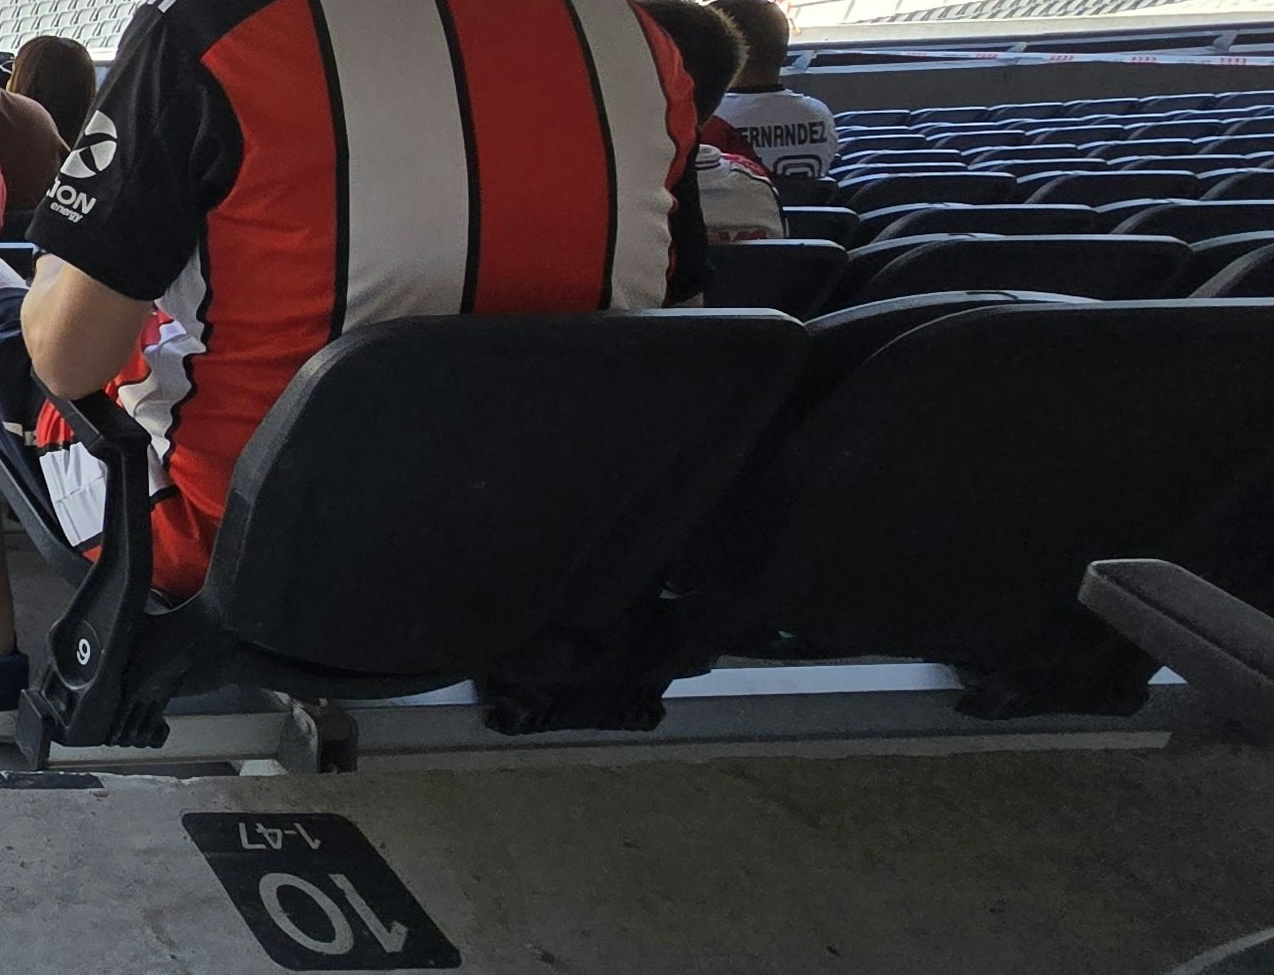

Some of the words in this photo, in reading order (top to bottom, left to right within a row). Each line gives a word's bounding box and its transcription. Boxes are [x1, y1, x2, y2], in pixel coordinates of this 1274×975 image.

[727, 121, 828, 146] ERNANDEZ
[46, 176, 97, 215] ION
[50, 202, 84, 223] energy
[76, 638, 91, 666] 9
[238, 822, 322, 851] 1-47
[258, 872, 409, 956] 10
